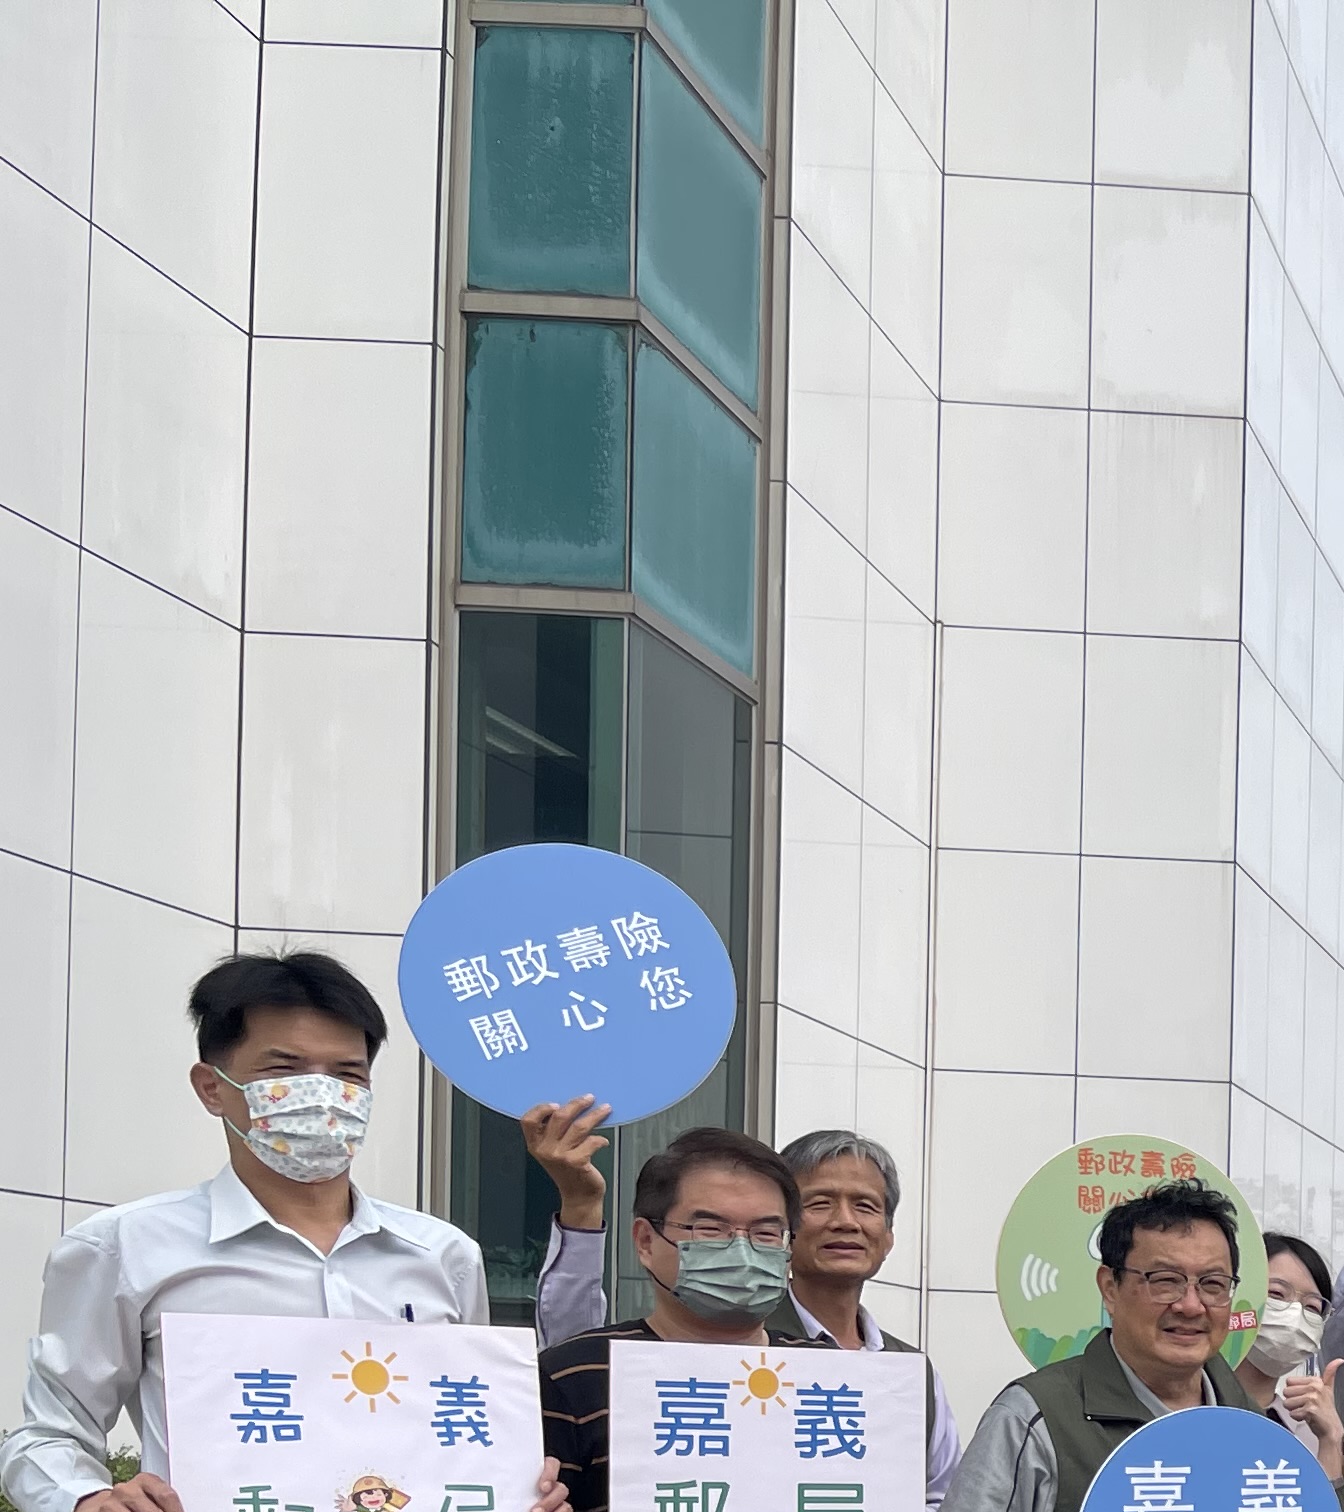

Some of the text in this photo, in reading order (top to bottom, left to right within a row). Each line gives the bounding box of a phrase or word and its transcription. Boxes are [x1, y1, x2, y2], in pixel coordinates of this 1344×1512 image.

[442, 911, 671, 1002] 郵政壽險
[468, 965, 693, 1061] 關心您
[1077, 1147, 1197, 1179] 郵政壽險
[230, 1368, 493, 1448] 嘉義
[653, 1377, 867, 1460] 嘉義
